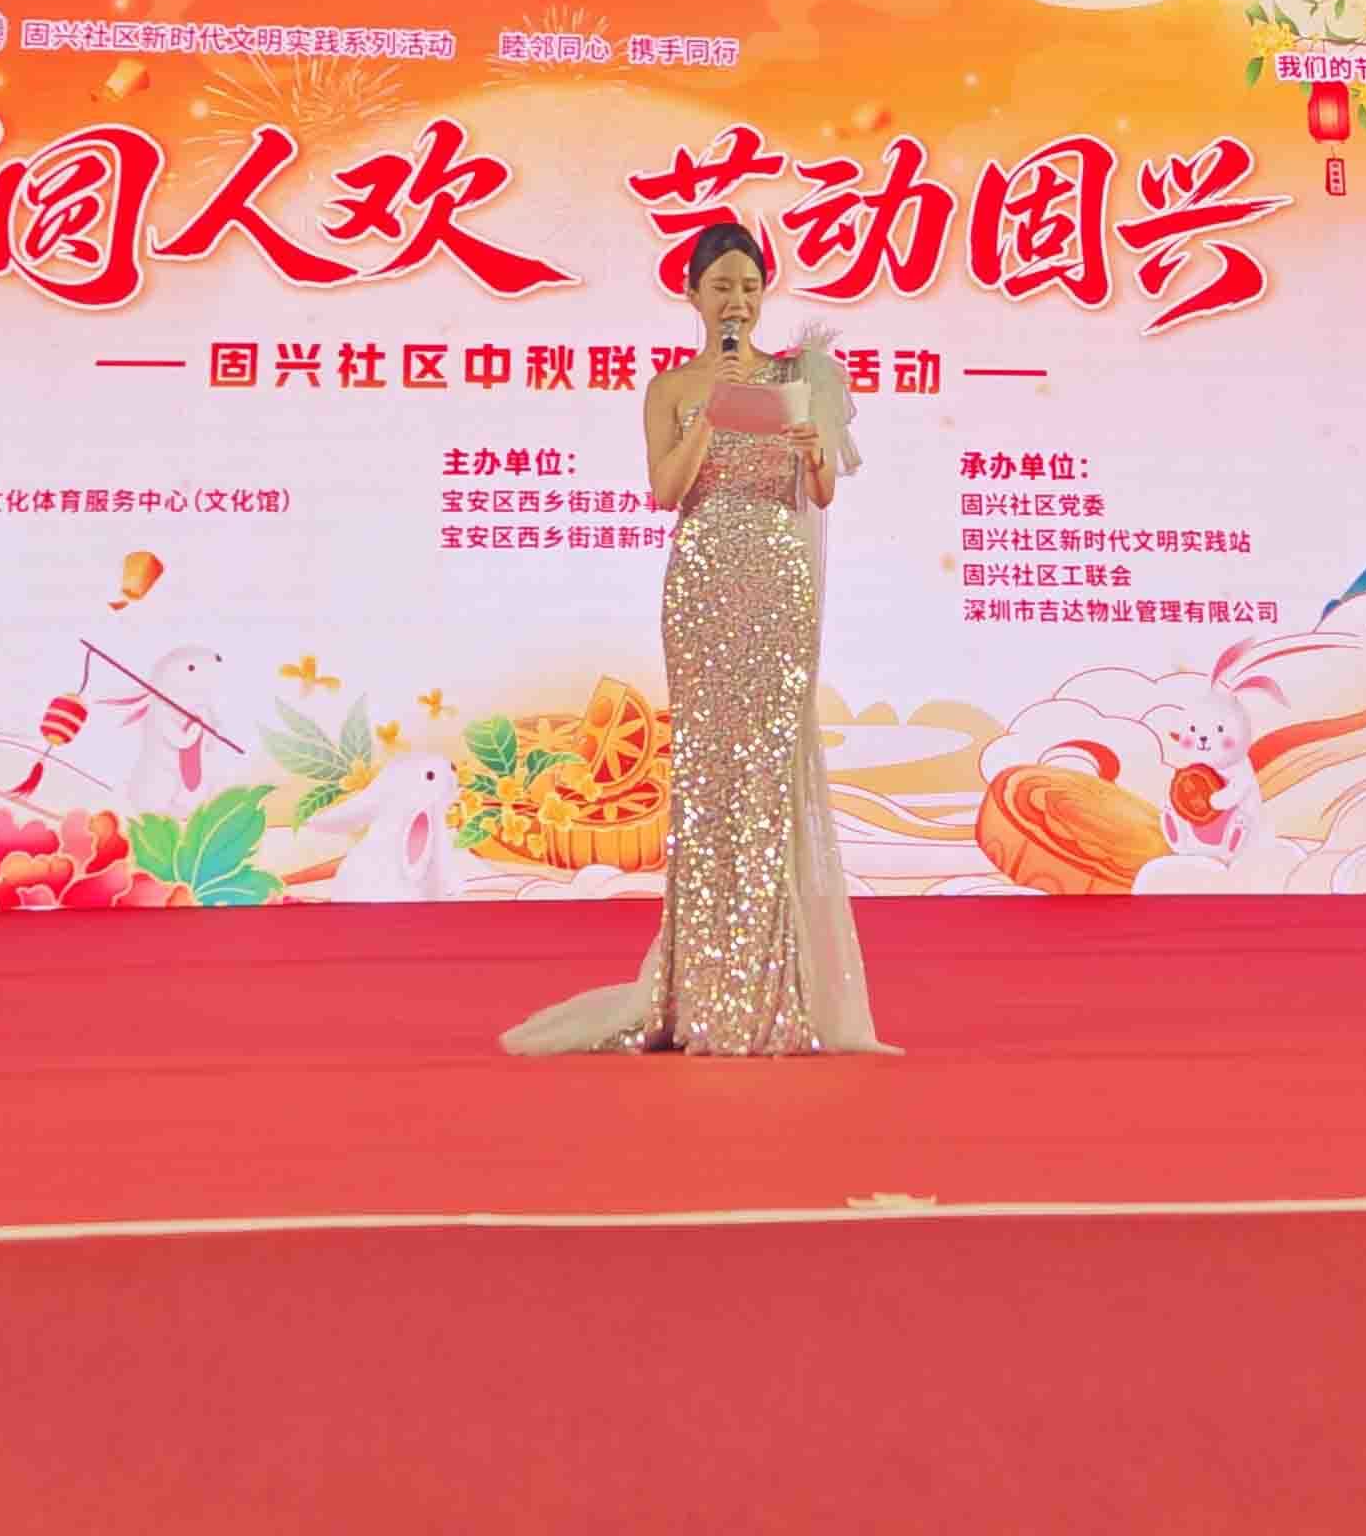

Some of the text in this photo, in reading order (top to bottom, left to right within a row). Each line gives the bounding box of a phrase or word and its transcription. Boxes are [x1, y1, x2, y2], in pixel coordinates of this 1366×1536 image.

[23, 21, 739, 64] 固兴社区新时代文明实践系列活动 睦邻同心 携手同行
[210, 342, 941, 395] 固兴社区中秋联活动
[442, 447, 578, 477] 主办单位：
[960, 452, 1089, 481] 承办单位：
[961, 493, 1106, 518] 固兴社区党委
[962, 528, 1252, 554] 固兴社区新时代文明实践站
[963, 563, 1133, 588] 固兴社区工联会
[963, 598, 1281, 625] 深圳市吉达物业管理有限公司
